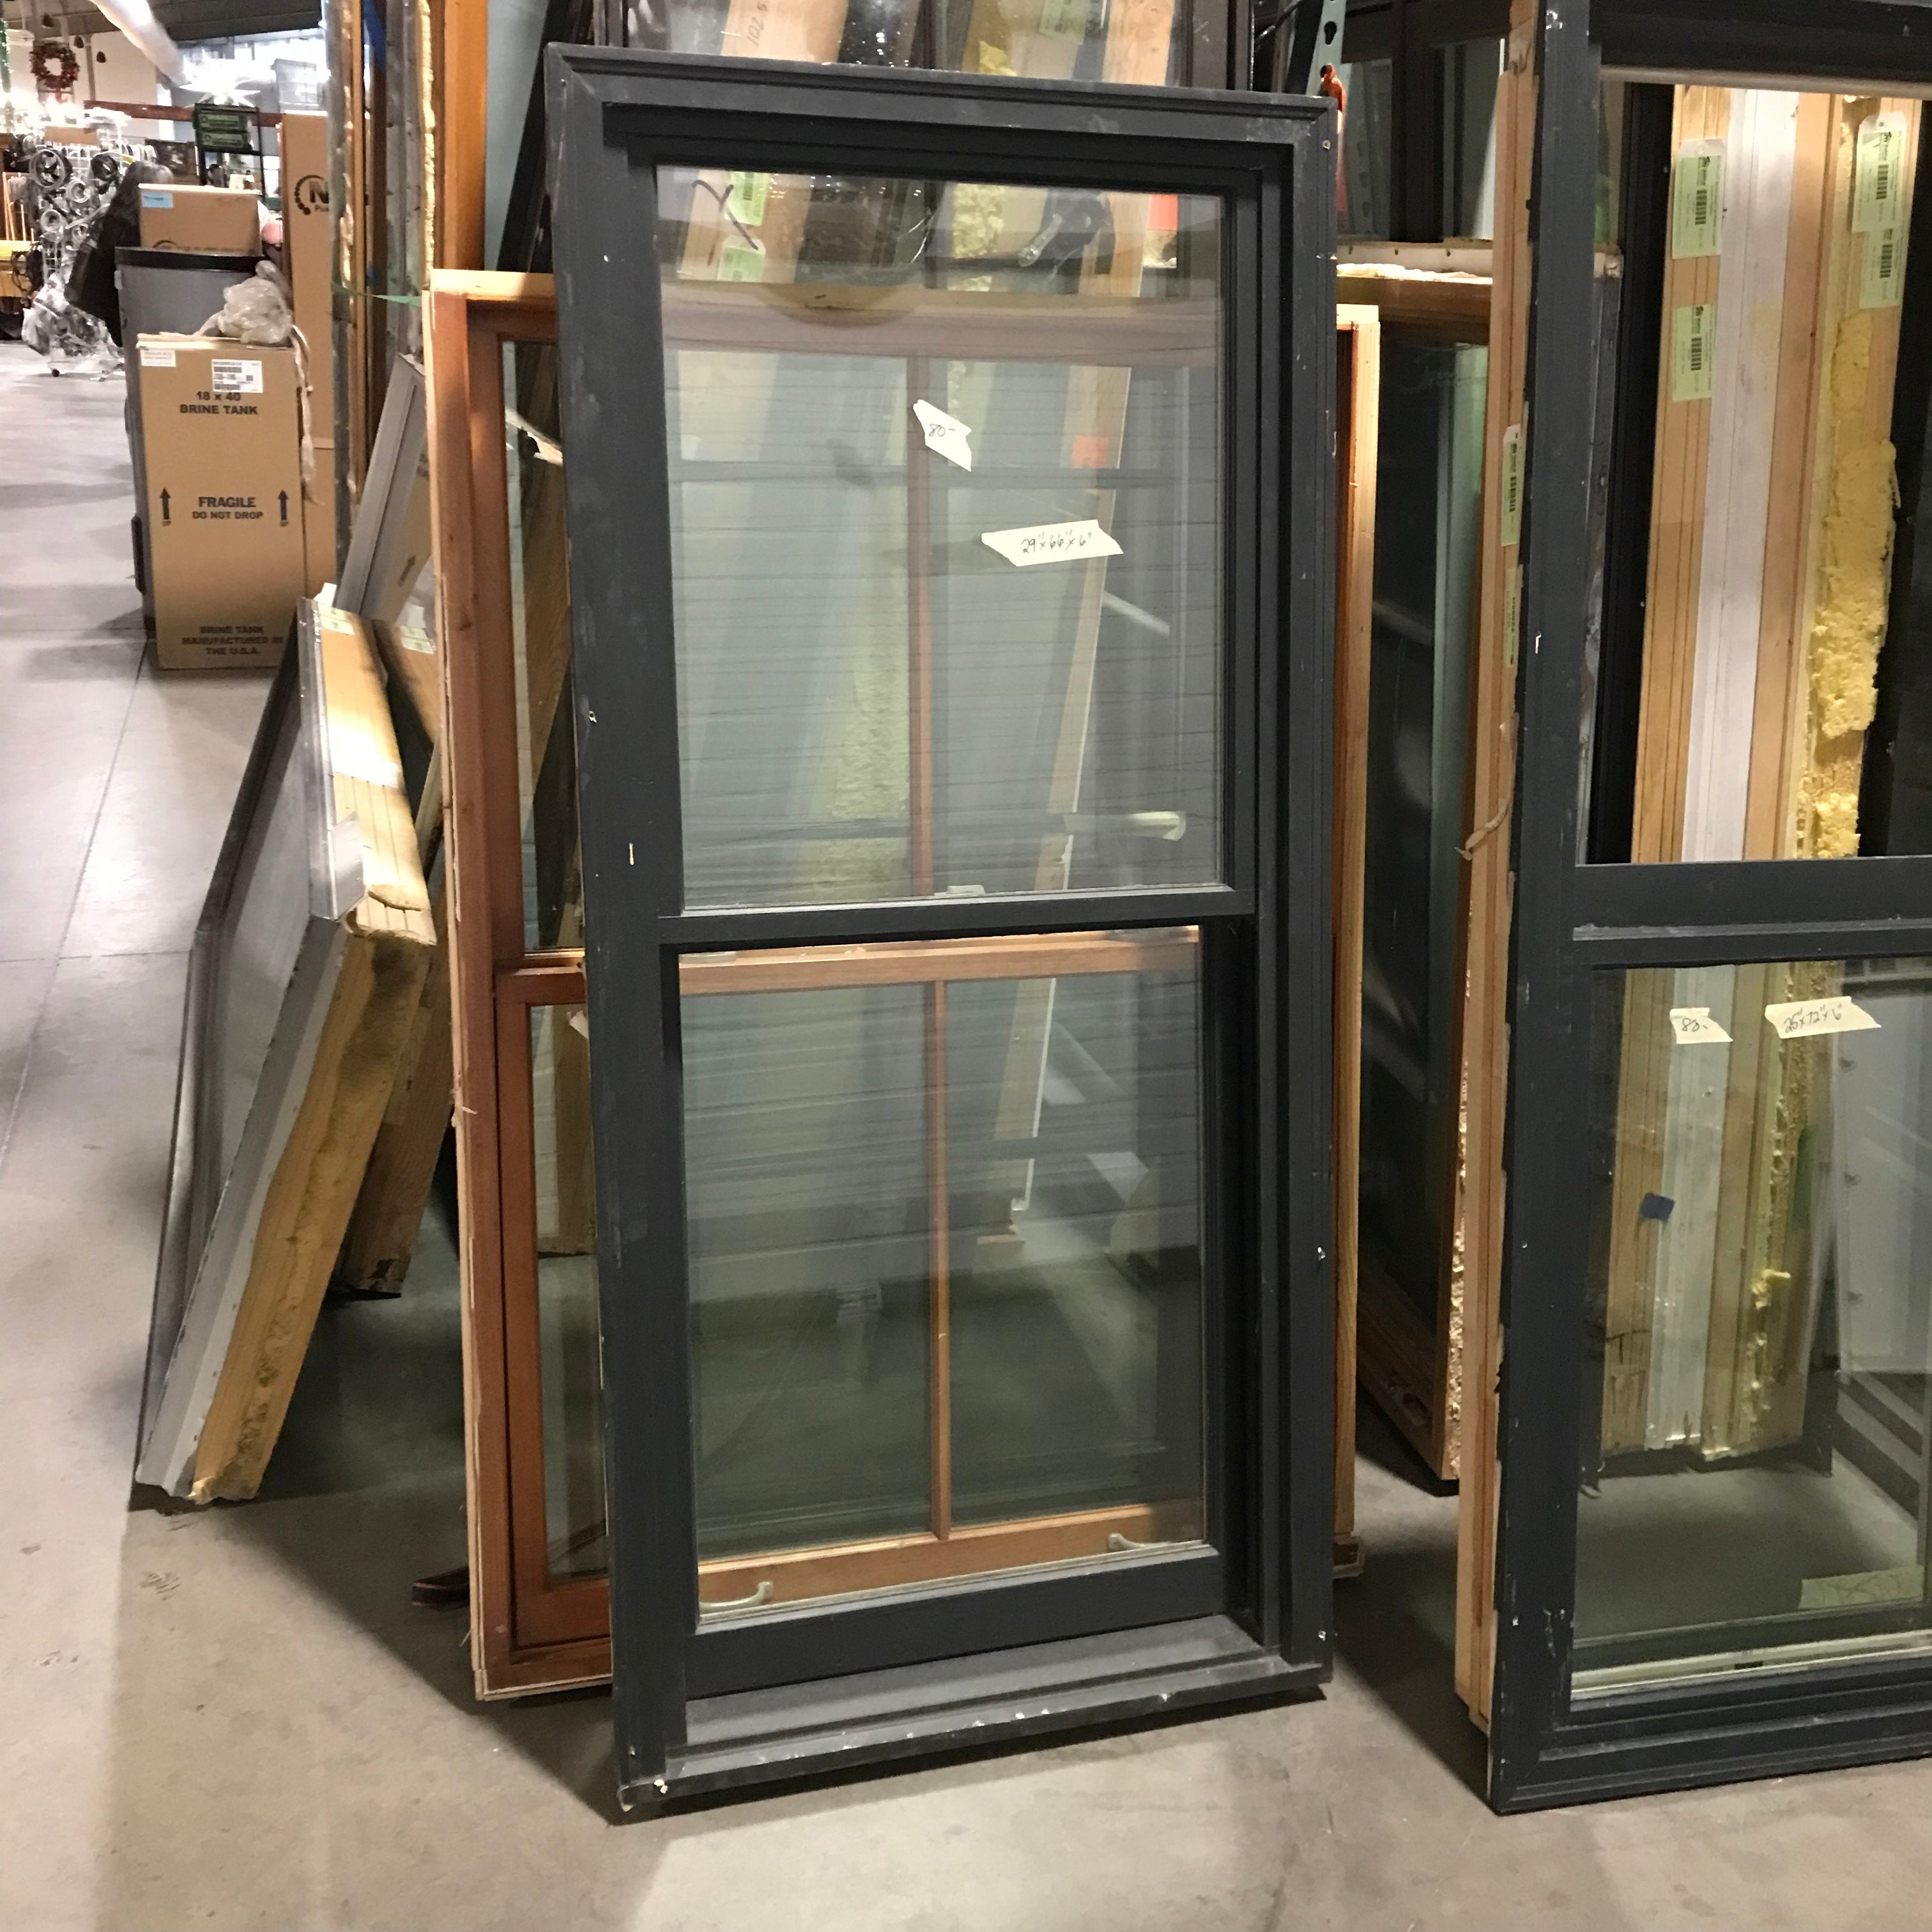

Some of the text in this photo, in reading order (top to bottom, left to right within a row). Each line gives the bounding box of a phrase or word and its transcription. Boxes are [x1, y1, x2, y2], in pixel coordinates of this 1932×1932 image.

[197, 391, 211, 401] 18
[226, 392, 241, 401] 40
[180, 404, 258, 415] BRINE TANK
[199, 496, 256, 507] FRAGILE
